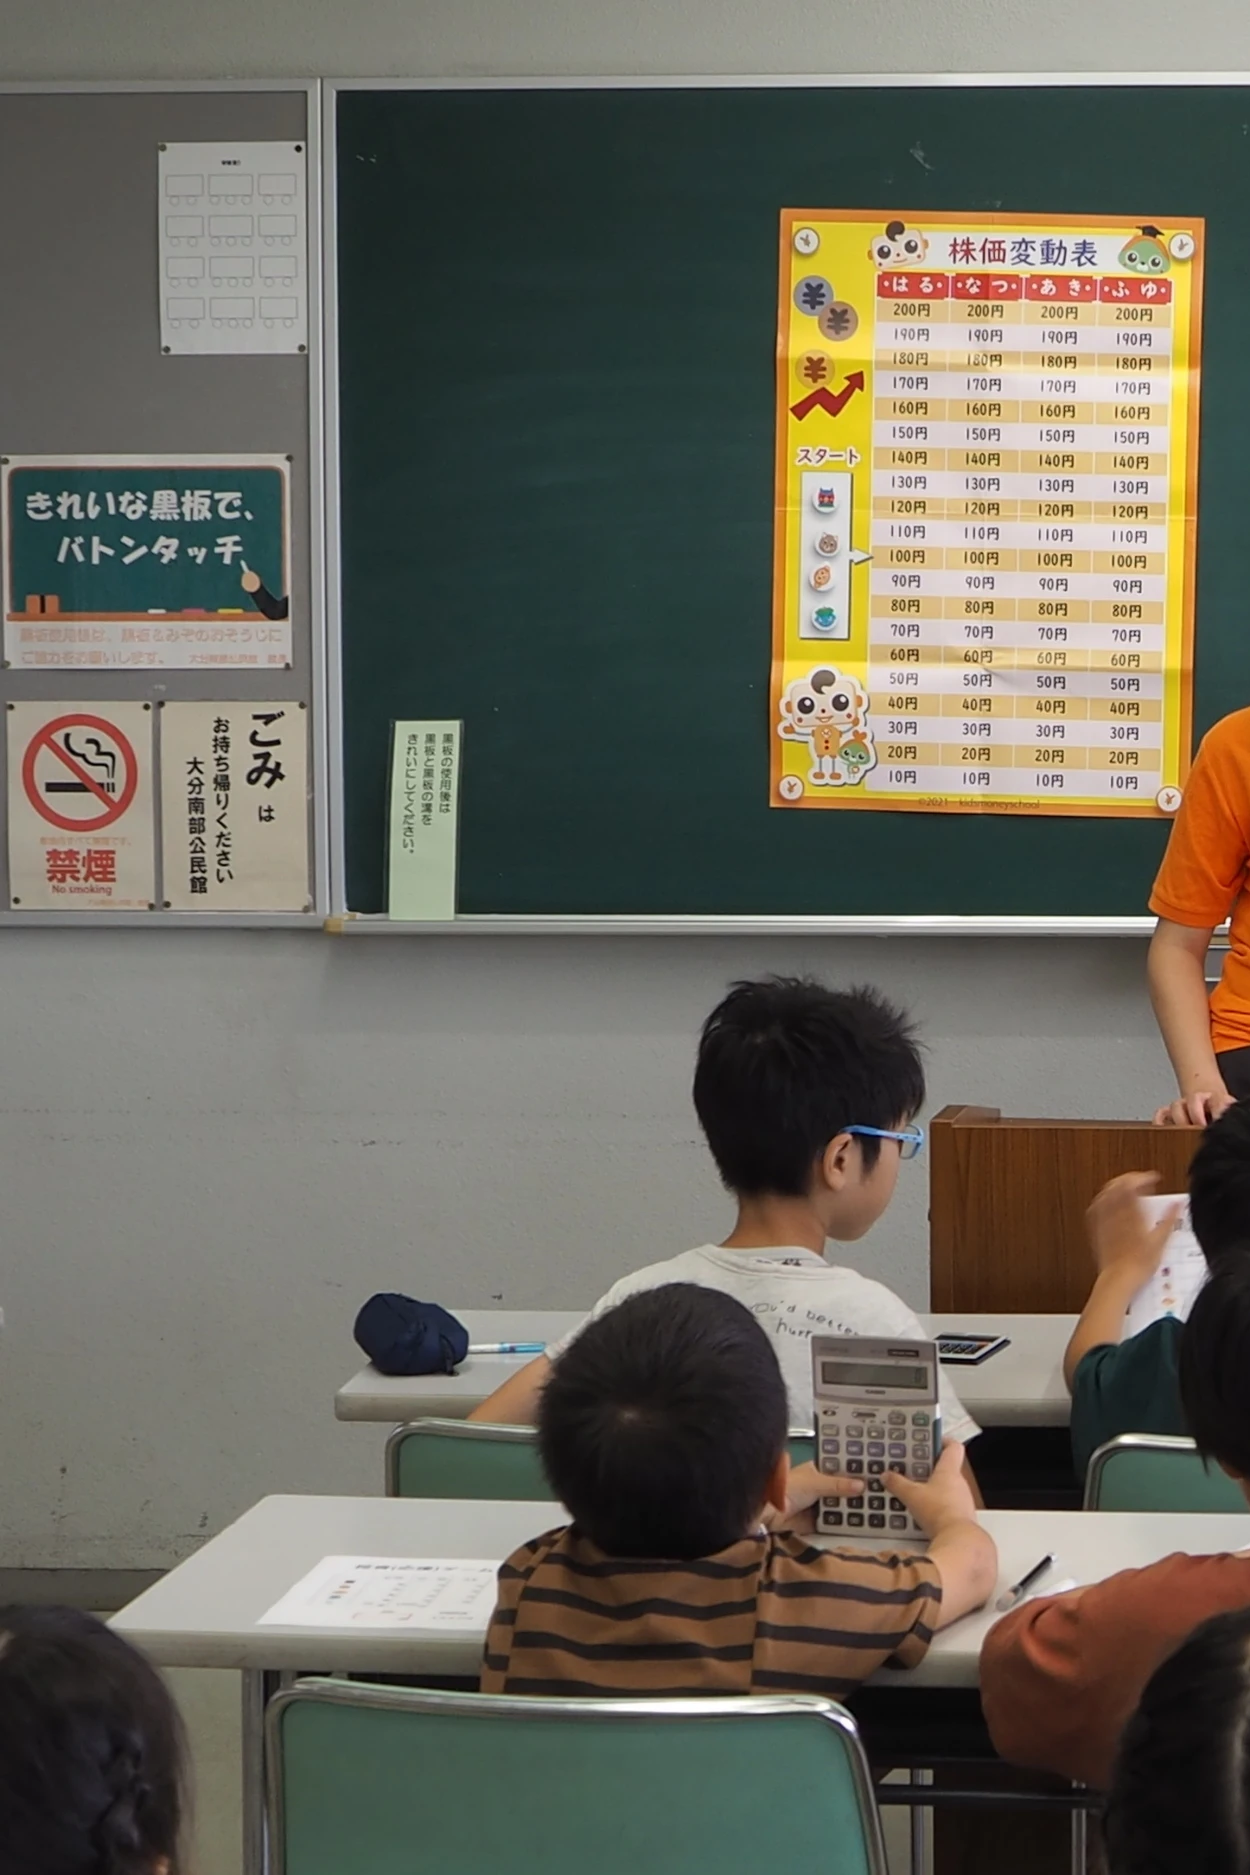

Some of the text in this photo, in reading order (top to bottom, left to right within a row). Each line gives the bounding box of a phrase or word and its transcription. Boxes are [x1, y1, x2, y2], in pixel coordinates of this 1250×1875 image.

[947, 237, 1099, 267] 株価変動表
[893, 278, 1156, 297] はる なつ あき ふゆ
[893, 302, 1153, 321] 200円 200円 200円 200円
[894, 327, 1152, 348] 190円 190円 190円 190円
[892, 352, 1152, 372] 180円 180円 180円 180円
[893, 376, 1151, 396] 170円 170円 170円 170円
[892, 401, 1151, 421] 160円 160円 160円 160円
[892, 426, 1150, 446] 150円 150円 150円 150円
[797, 448, 860, 464] スタート
[892, 450, 1149, 471] 140円 140円 140円 140円
[891, 475, 1149, 495] 130円 130円 130円 130円
[26, 490, 254, 521] きれいな黒板で、
[891, 499, 1149, 520] 120円 120円 120円 120円
[890, 524, 1148, 545] 110円 110円 110円 110円
[57, 535, 243, 565] バトンタッチ
[889, 549, 1147, 570] 100円 100円 100円 100円
[891, 574, 1143, 594] 90円 90円 90円 90円
[890, 598, 1142, 619] 80円 80円 80円 80円
[890, 623, 1142, 644] 70円 70円 70円 70円
[889, 648, 1141, 669] 60円 60円 60円 60円
[889, 672, 1140, 692] 50円 50円 50円 50円
[887, 696, 1140, 717] 40円 40円 40円 40円
[888, 720, 1140, 741] 30円 30円 30円 30円
[887, 745, 1139, 766] 20円 20円 20円 20円
[439, 733, 454, 814] 黒板の使用後は
[888, 770, 1138, 791] 10円 10円 10円 10円
[212, 716, 234, 883] お持ち帰りください
[402, 734, 418, 854] きれいにしてください。
[186, 756, 208, 894] 大分南部公民館
[46, 848, 116, 883] 禁煙
[52, 885, 112, 896] No smoking
